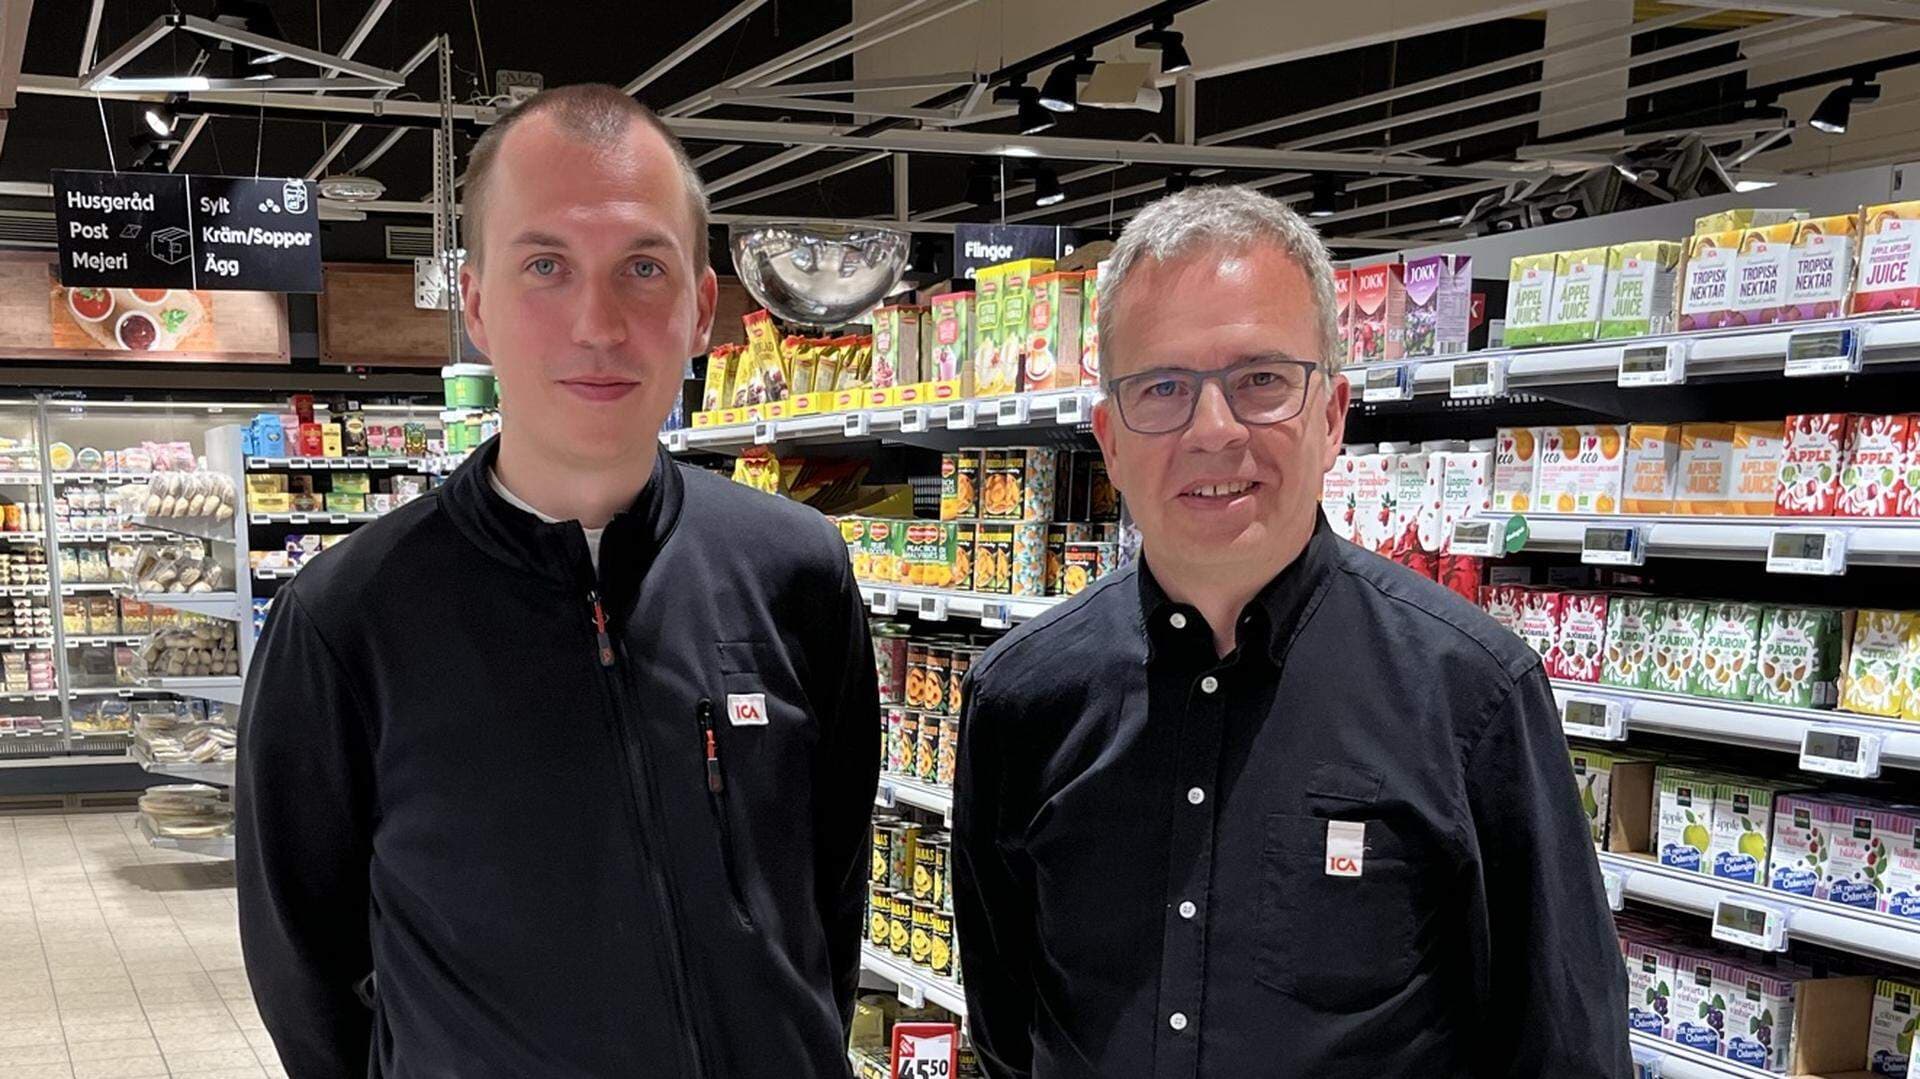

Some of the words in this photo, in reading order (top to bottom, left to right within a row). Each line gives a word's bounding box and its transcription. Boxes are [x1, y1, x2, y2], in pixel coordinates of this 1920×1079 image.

[66, 190, 154, 214] Husgeråd
[200, 197, 230, 216] Sylt
[70, 222, 109, 240] Post
[202, 226, 312, 249] Kräm/Soppor
[964, 241, 1014, 262] Flingor
[72, 252, 128, 273] Mejeri
[204, 253, 240, 277] Ägg
[1798, 257, 1834, 274] TROPISK
[1410, 264, 1438, 284] JOKK
[1692, 268, 1728, 284] TROPISK
[1742, 264, 1778, 280] TROPISK
[1866, 261, 1908, 286] JUICE
[1358, 273, 1386, 292] JOKK
[1740, 279, 1778, 297] NEKTAR
[1795, 273, 1832, 290] NEKTAR
[1690, 284, 1726, 300] NEKTAR
[1512, 306, 1541, 324] JUICE
[1558, 301, 1588, 320] JUICE
[1612, 298, 1642, 316] JUICE
[1498, 454, 1514, 464] eco
[1544, 452, 1560, 464] eco
[1581, 452, 1598, 464] eco
[1786, 446, 1832, 462] ÄPPLE
[1632, 475, 1664, 493] JUICE
[1686, 476, 1720, 494] JUICE
[1738, 476, 1776, 494] JUICE
[1766, 642, 1808, 657] PÄRON
[736, 704, 760, 719] ICA
[1330, 856, 1358, 872] ICA
[930, 1060, 948, 1076] 50
